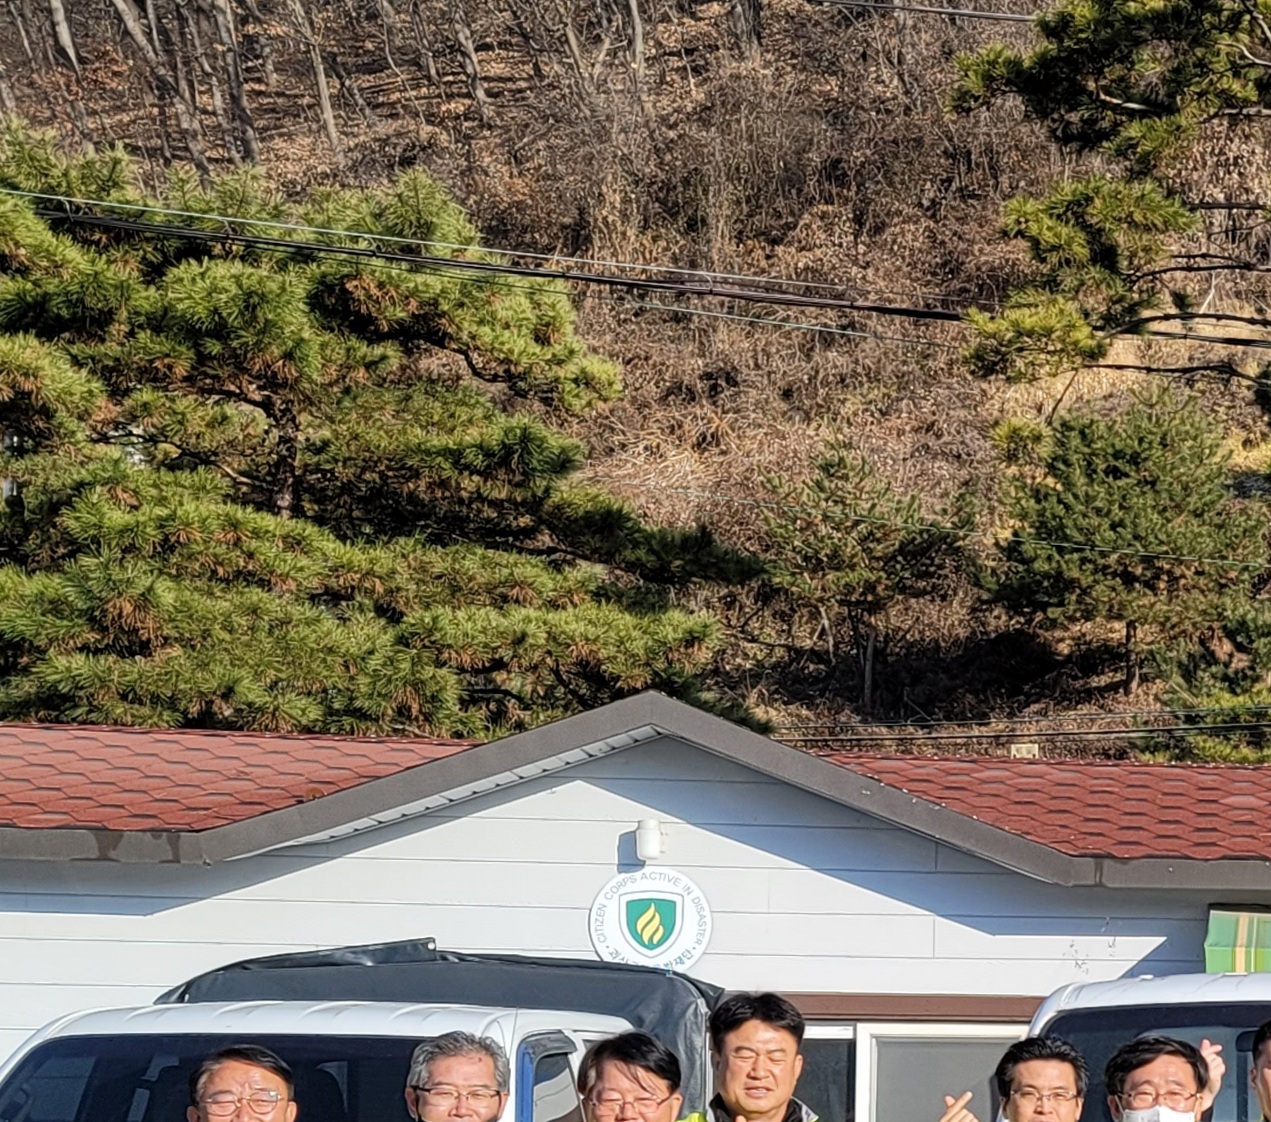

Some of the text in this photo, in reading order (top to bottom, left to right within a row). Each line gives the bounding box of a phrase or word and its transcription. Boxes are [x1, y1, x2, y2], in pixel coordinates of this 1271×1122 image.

[594, 871, 707, 946] CITIZEN CORPS ACTIVE IN DISASTER
